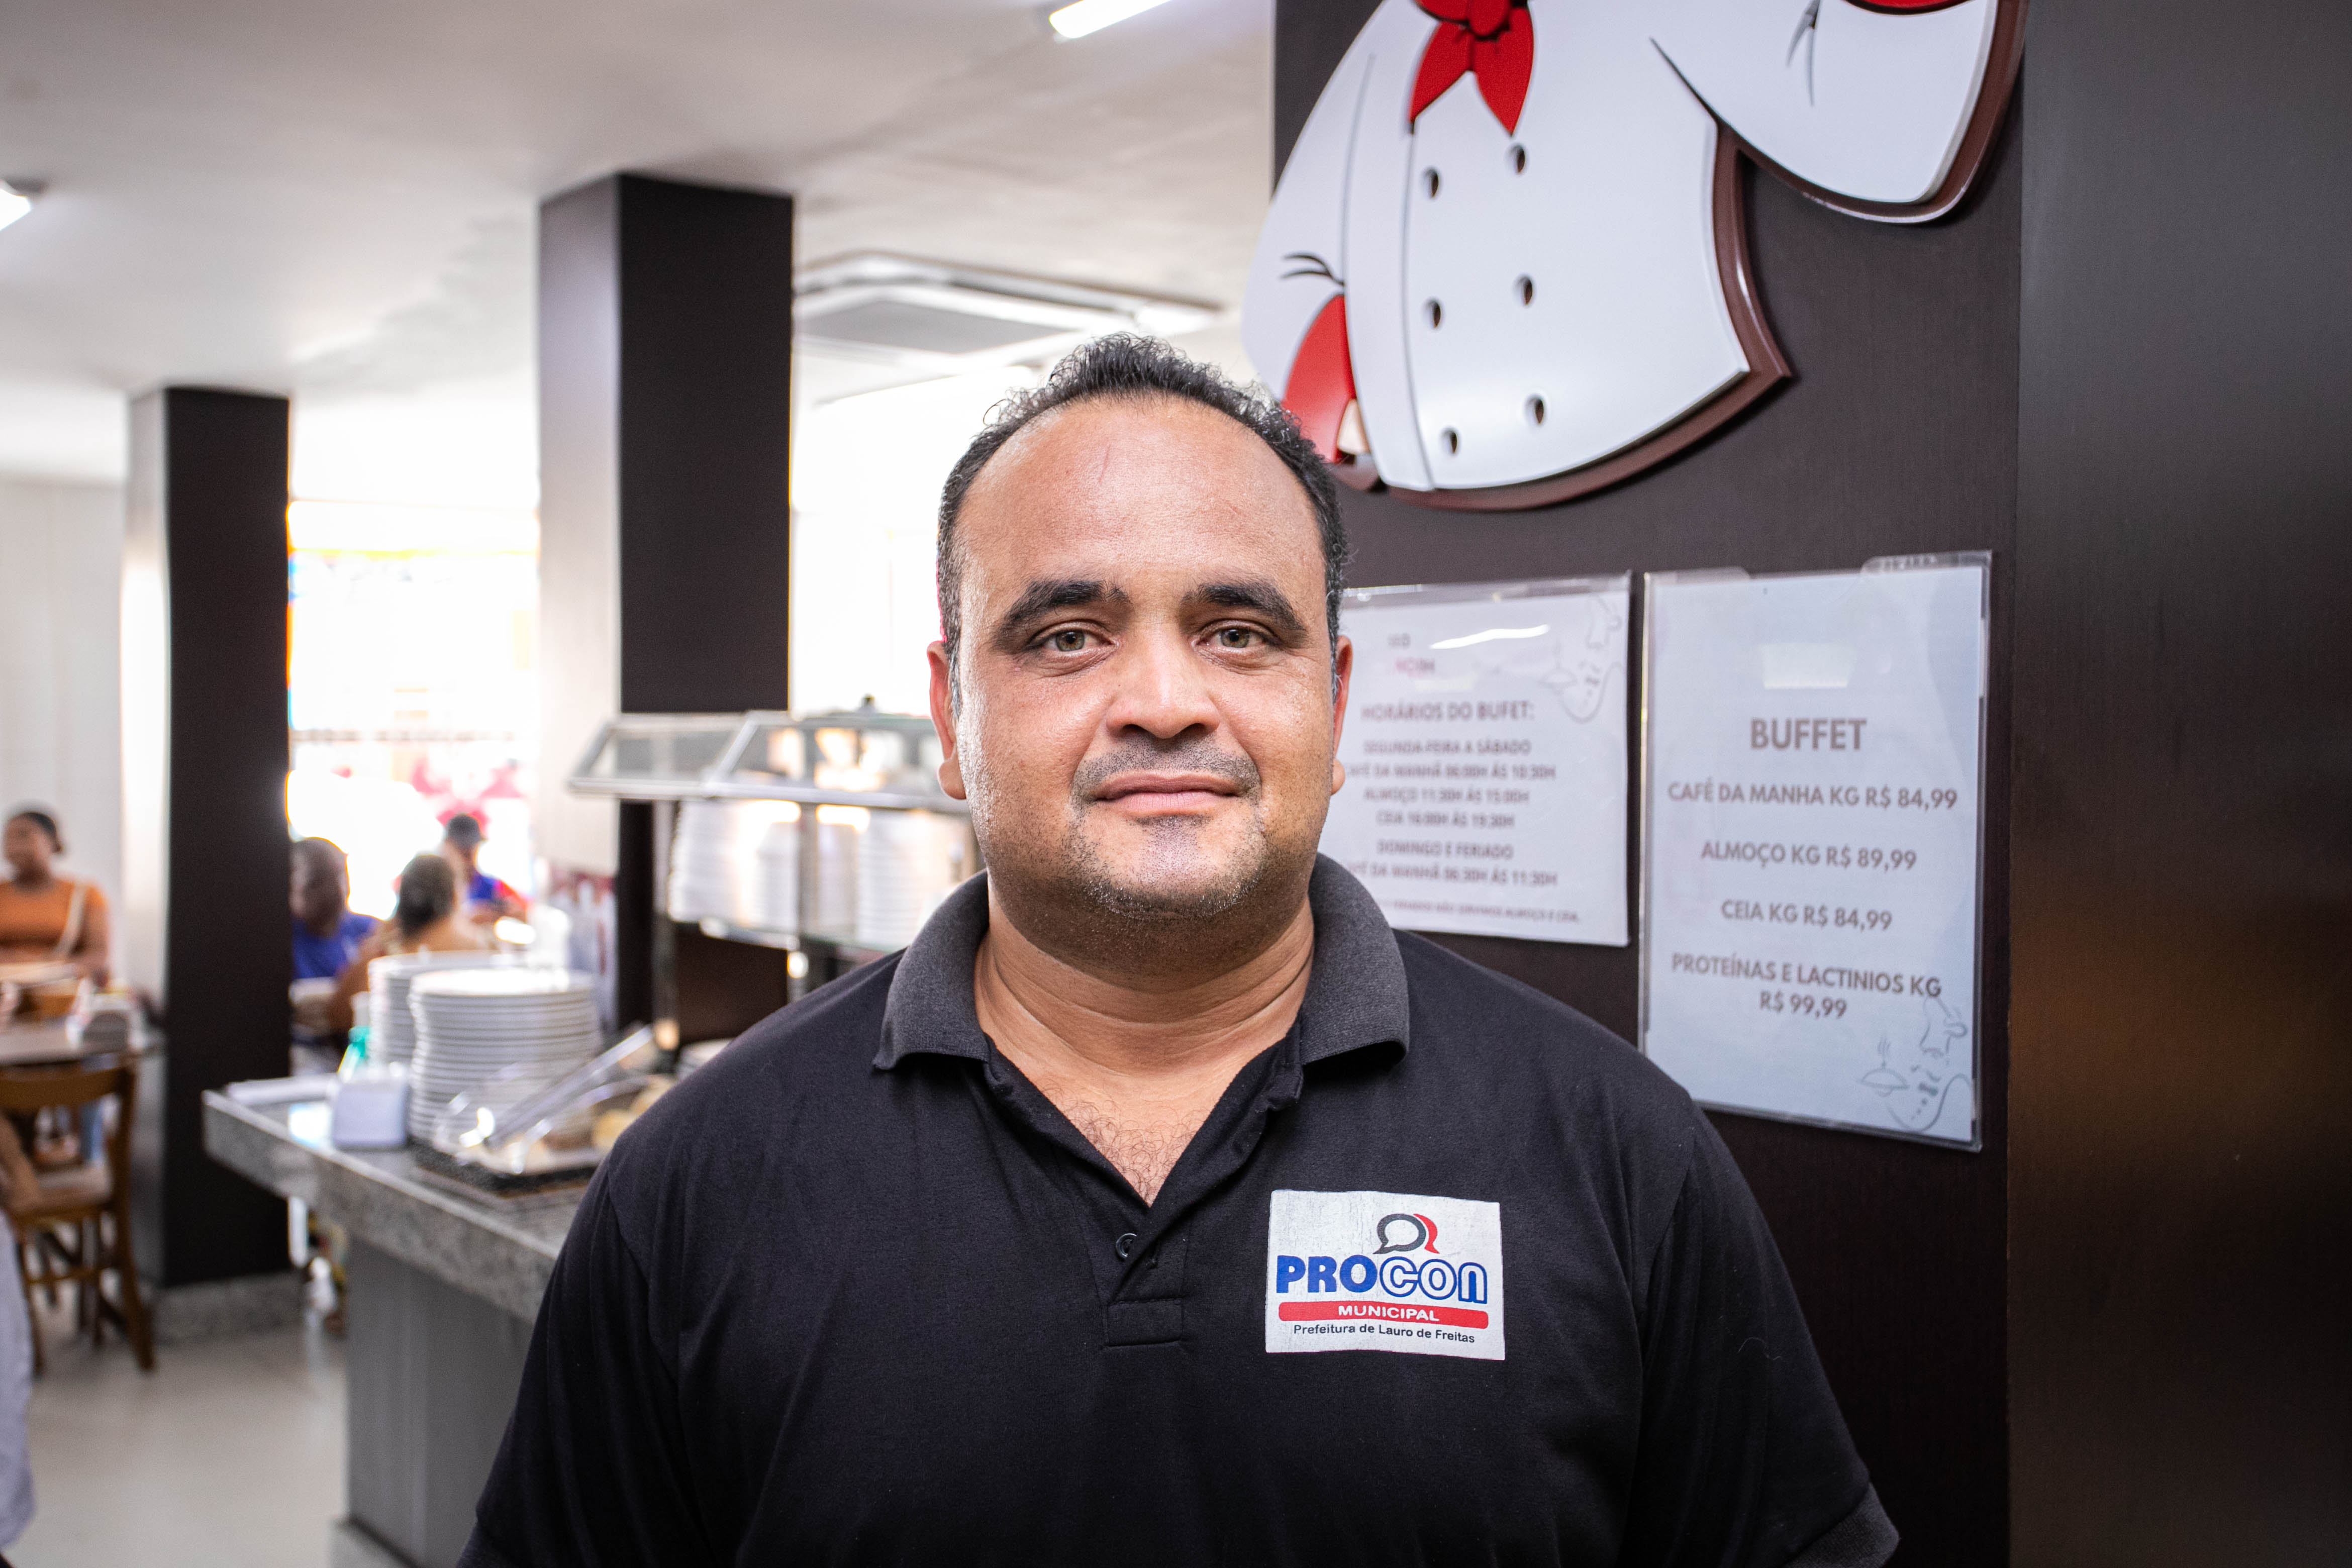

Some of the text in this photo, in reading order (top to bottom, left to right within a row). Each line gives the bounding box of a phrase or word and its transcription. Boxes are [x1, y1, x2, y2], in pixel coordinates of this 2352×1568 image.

[1448, 702, 1471, 721] DO
[1750, 718, 1867, 751] BUFFET
[1667, 777, 1958, 811] CAFÉ DA MANHA KG R$ 84,99
[1700, 841, 1917, 870] ALMOÇO KG R$ 89,99
[1720, 899, 1892, 931] CEIA KG R$ 84,99
[1672, 952, 1942, 999] PROTEÍNAS E LACTINIOS KG
[1759, 991, 1847, 1019] R$ 99,99
[1338, 1305, 1439, 1322] MUNICIPAL
[1294, 1324, 1475, 1343] Prefeitura de Lauro de Freitas
